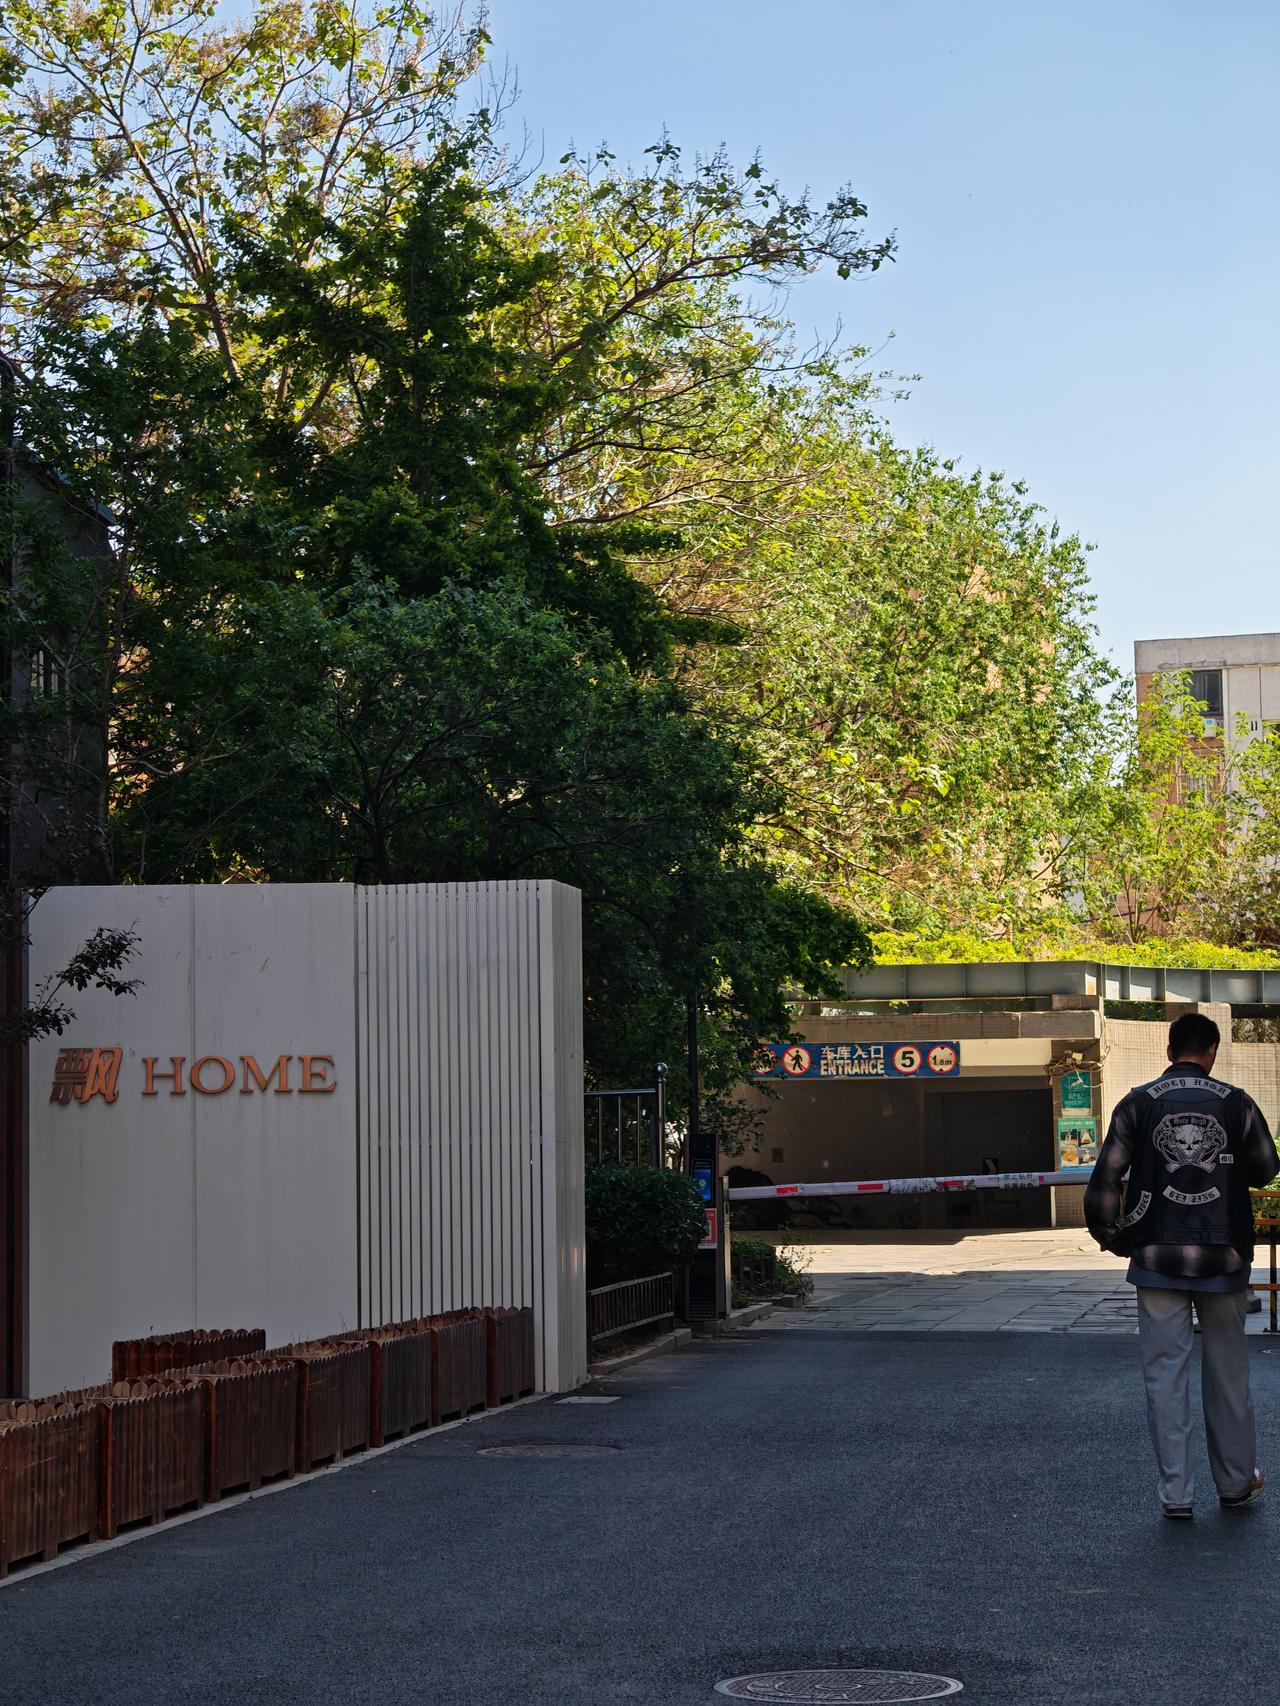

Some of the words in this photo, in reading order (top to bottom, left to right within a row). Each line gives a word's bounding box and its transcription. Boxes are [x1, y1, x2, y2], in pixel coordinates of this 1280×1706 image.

[820, 1044, 885, 1059] 车库入口
[901, 1051, 914, 1068] 5
[142, 1055, 337, 1095] HOME
[820, 1060, 885, 1076] ENTRANCE
[1152, 1079, 1186, 1094] HOLY
